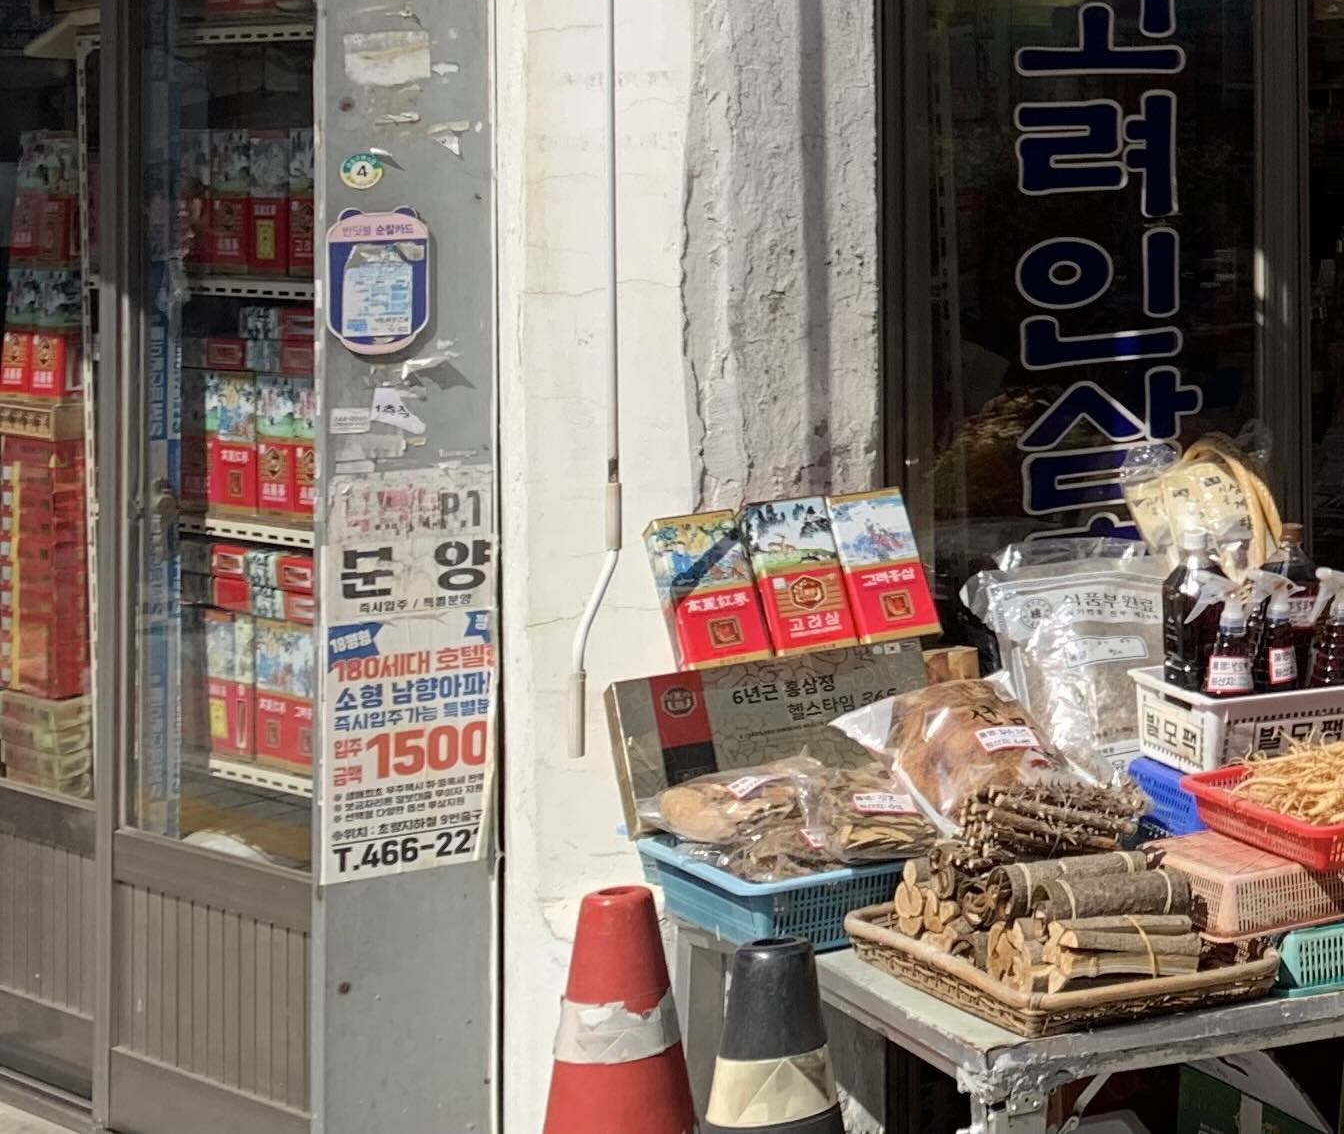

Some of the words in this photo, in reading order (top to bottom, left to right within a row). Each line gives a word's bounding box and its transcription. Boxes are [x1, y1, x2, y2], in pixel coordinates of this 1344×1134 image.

[861, 566, 917, 588] 고려홍삼
[334, 650, 431, 683] 180세대
[334, 682, 384, 713] 소형
[391, 671, 491, 705] 남향아파
[731, 684, 779, 706] 6년근
[784, 673, 837, 699] 홍삼정
[333, 737, 363, 760] 입주
[365, 720, 488, 780] 1500
[1146, 710, 1199, 756] 발모팩
